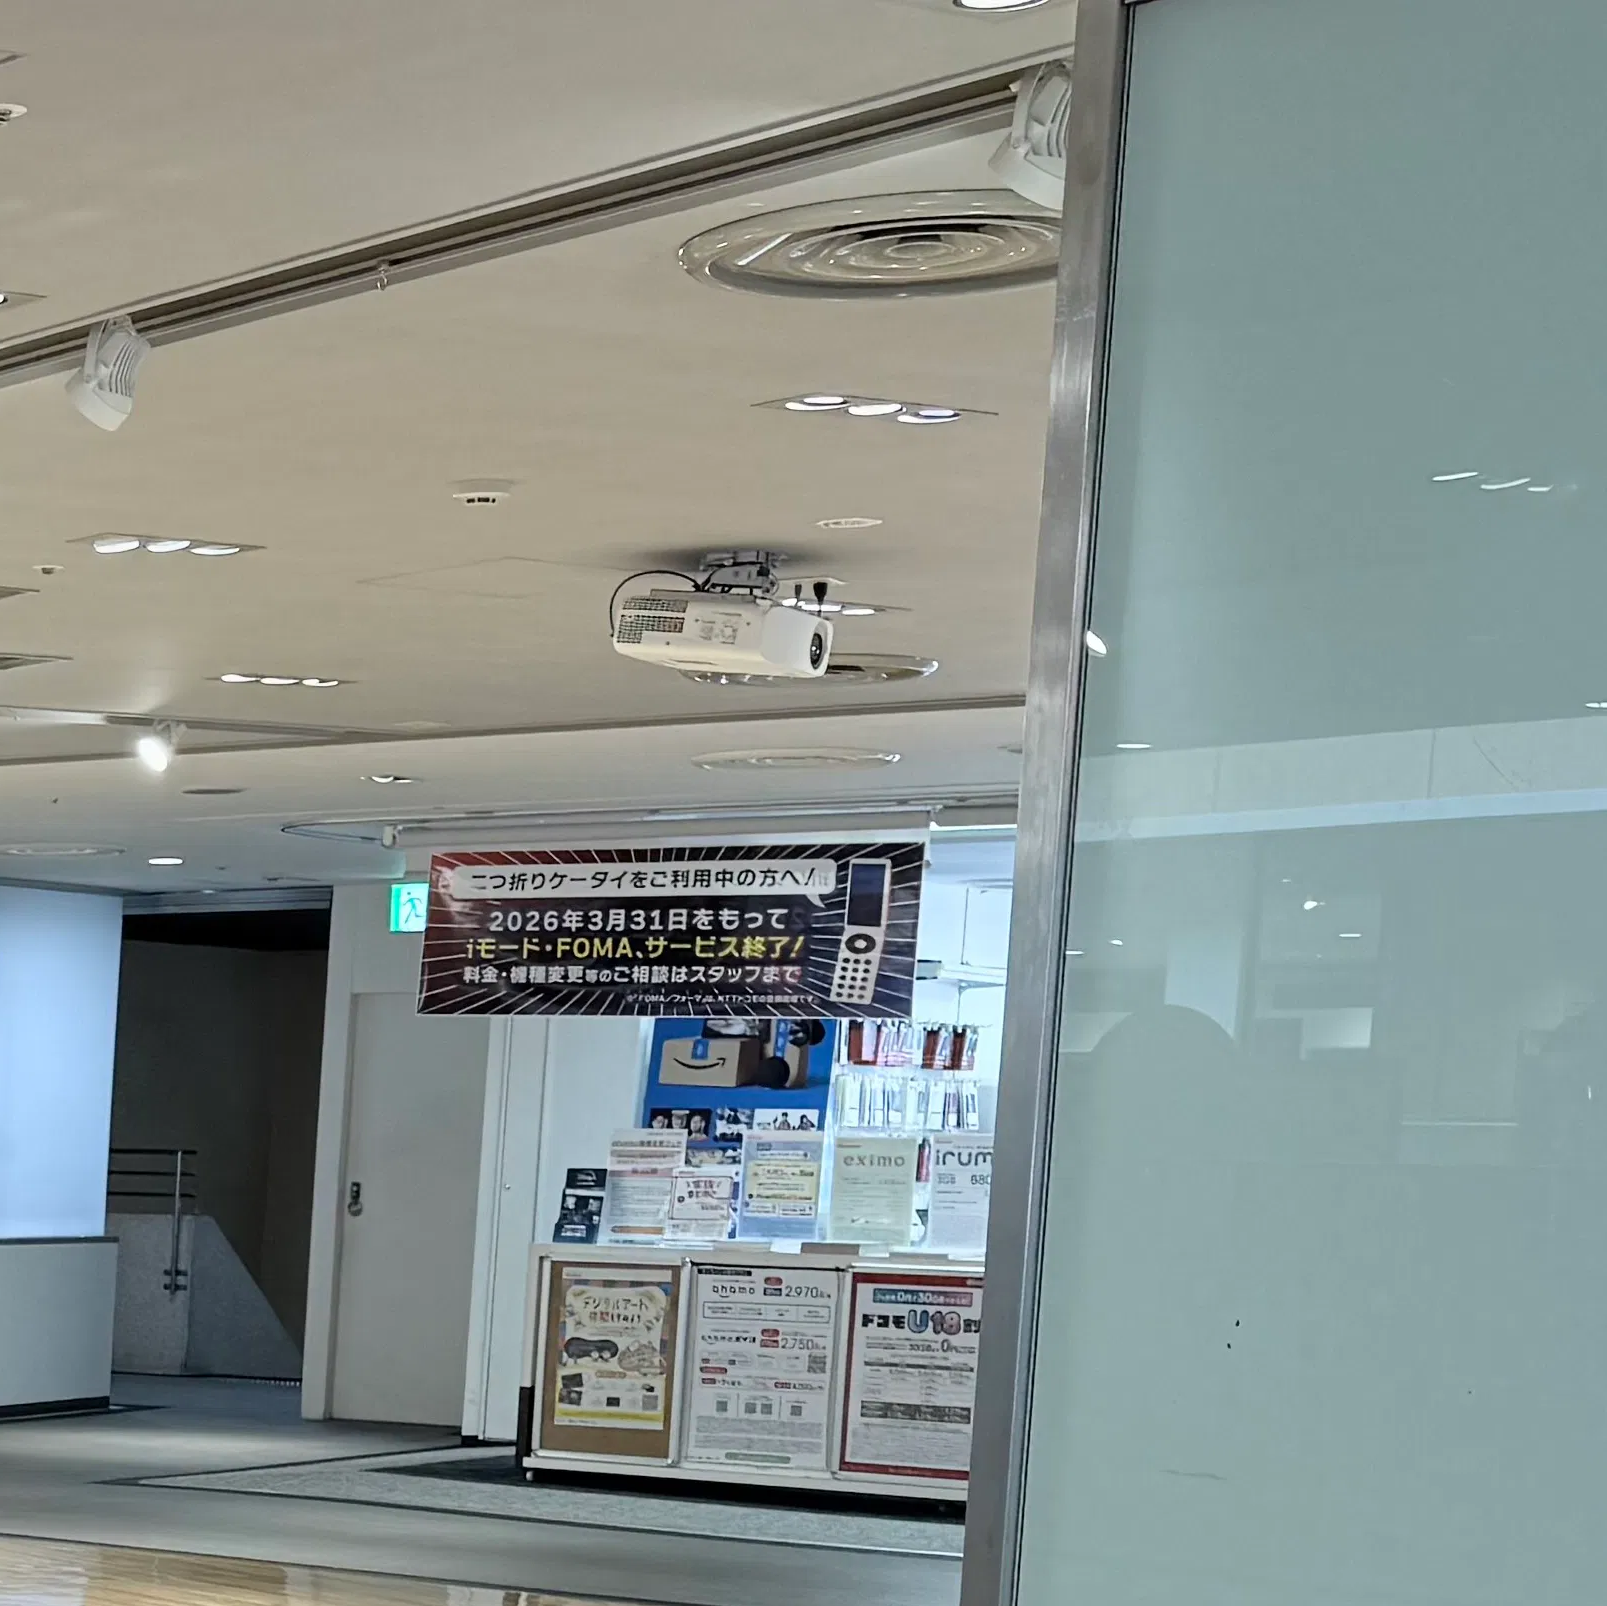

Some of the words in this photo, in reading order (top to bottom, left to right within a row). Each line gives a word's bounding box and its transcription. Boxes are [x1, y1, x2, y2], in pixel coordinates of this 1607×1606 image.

[470, 866, 815, 891] 二つ折りケータイをご利用中の方へ!
[488, 907, 789, 933] 2026年3月31日をもって
[843, 1153, 906, 1167] eximo
[936, 1149, 992, 1167] irum
